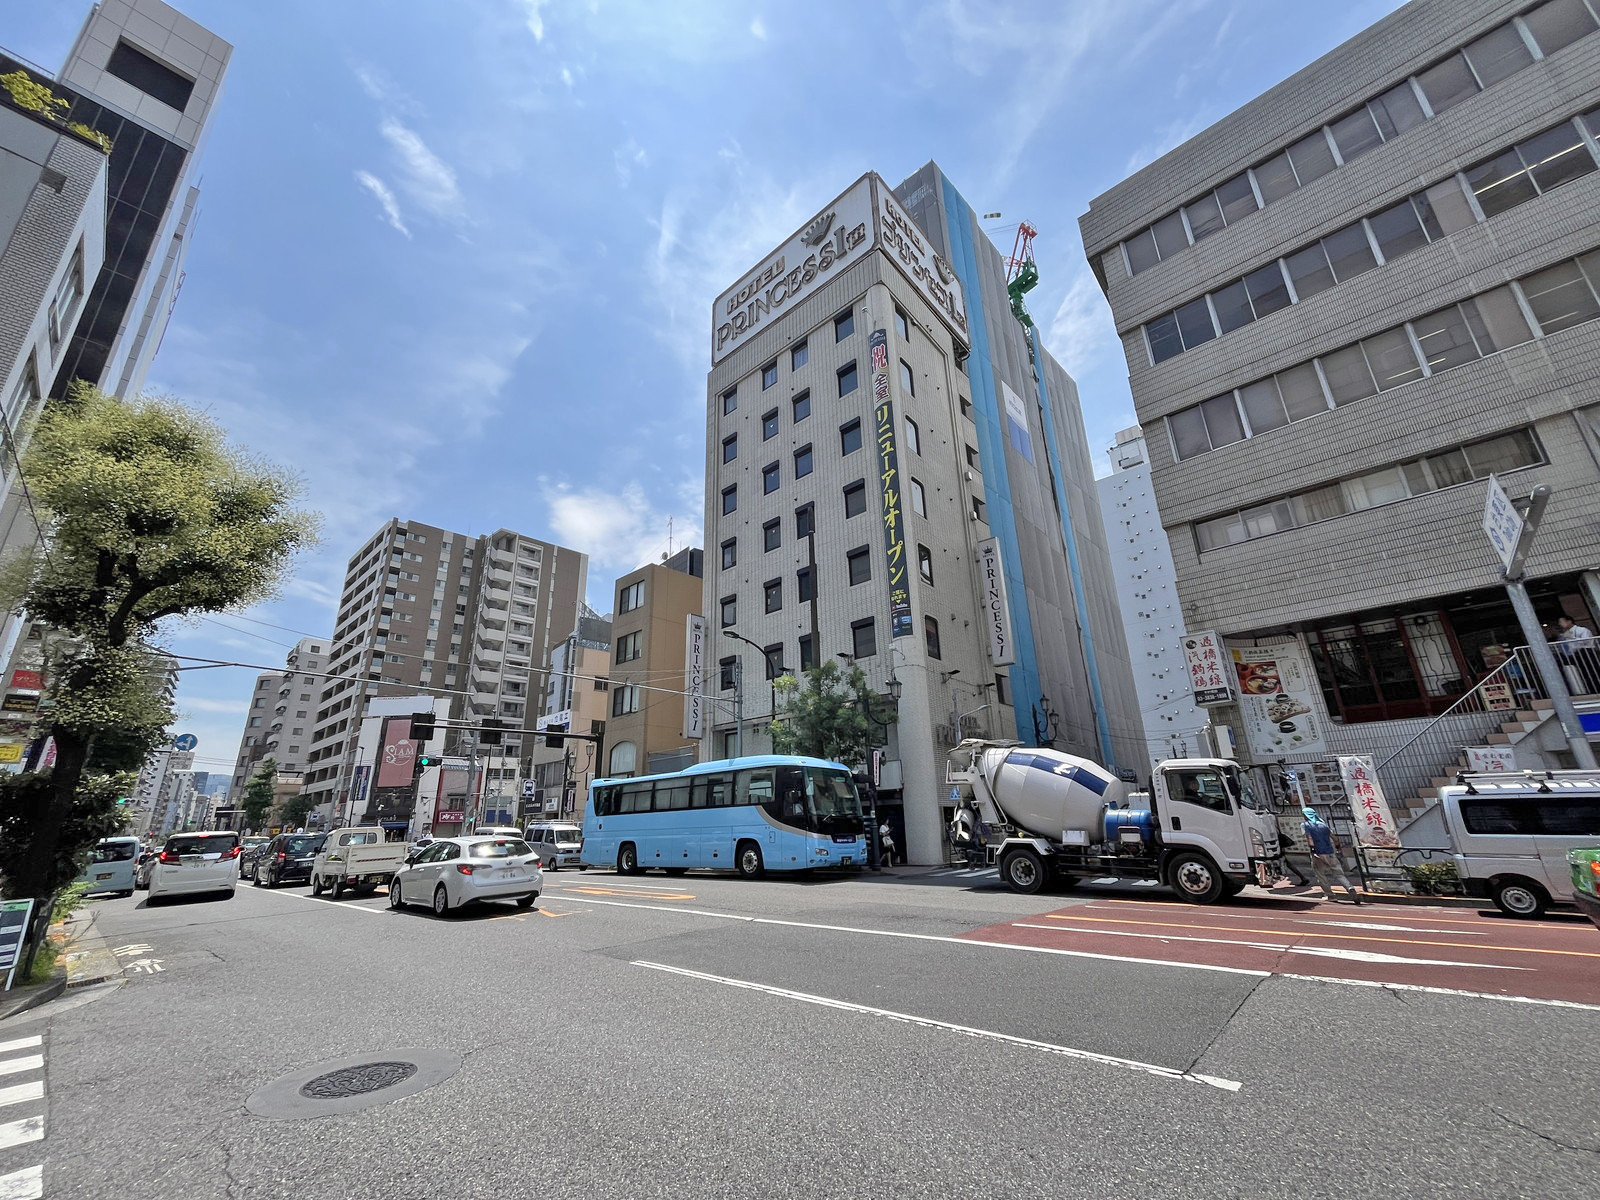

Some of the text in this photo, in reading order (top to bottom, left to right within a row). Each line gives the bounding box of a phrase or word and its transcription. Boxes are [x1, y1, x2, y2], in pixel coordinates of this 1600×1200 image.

[885, 197, 926, 258] HOTEL
[727, 255, 786, 315] HOTEL
[877, 404, 906, 587] リニューアルオープン
